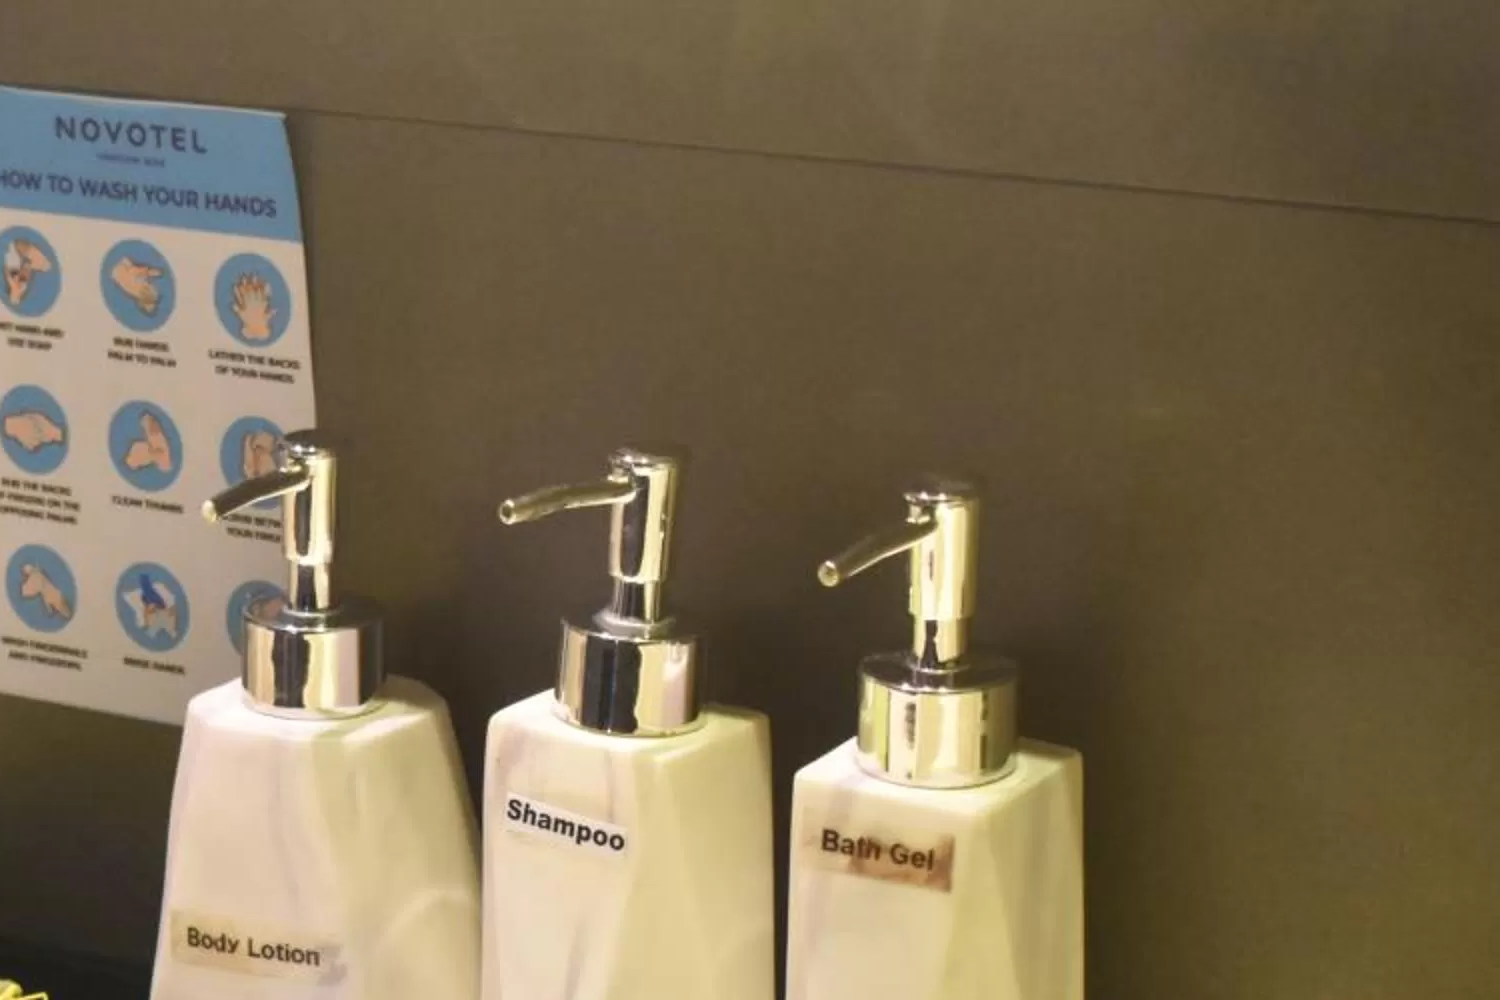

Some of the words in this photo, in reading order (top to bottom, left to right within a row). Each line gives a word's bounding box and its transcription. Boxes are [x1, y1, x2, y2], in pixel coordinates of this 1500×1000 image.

[55, 115, 208, 155] NOVOTEL
[47, 173, 73, 194] TO
[79, 176, 137, 204] WASH
[143, 184, 199, 212] YOUR
[204, 191, 277, 219] HANDS
[507, 799, 625, 851] Shampoo
[821, 828, 881, 861] Bath
[889, 843, 936, 871] Gel
[186, 926, 240, 954] Body
[247, 937, 321, 967] Lotion
